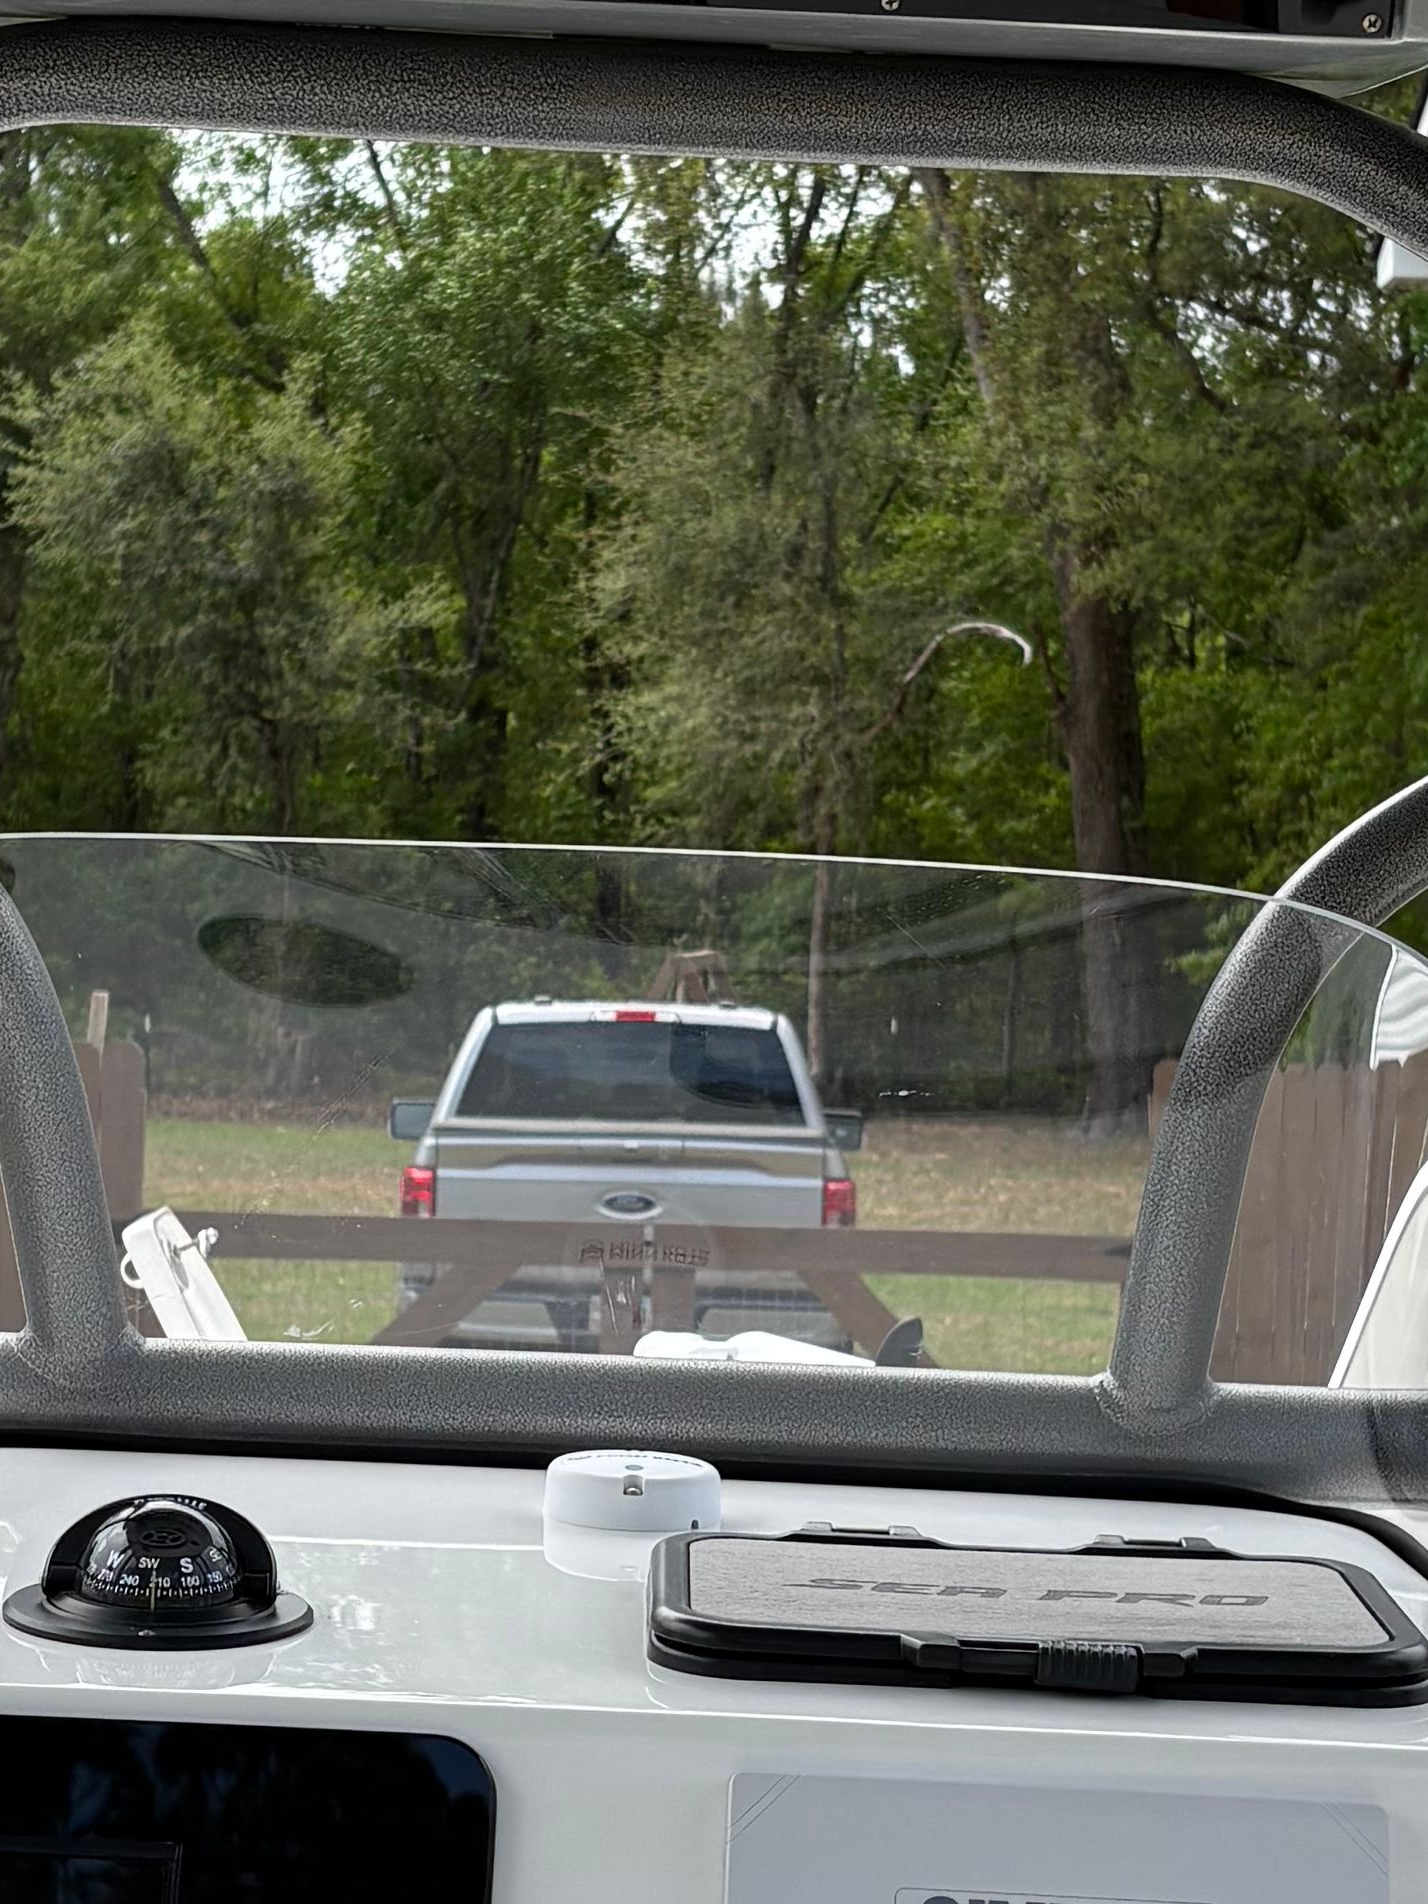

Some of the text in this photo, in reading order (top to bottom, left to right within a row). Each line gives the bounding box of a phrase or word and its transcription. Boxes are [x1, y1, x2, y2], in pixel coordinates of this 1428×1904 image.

[106, 1550, 194, 1574] W SW S
[782, 1578, 1269, 1607] SEA PRO
